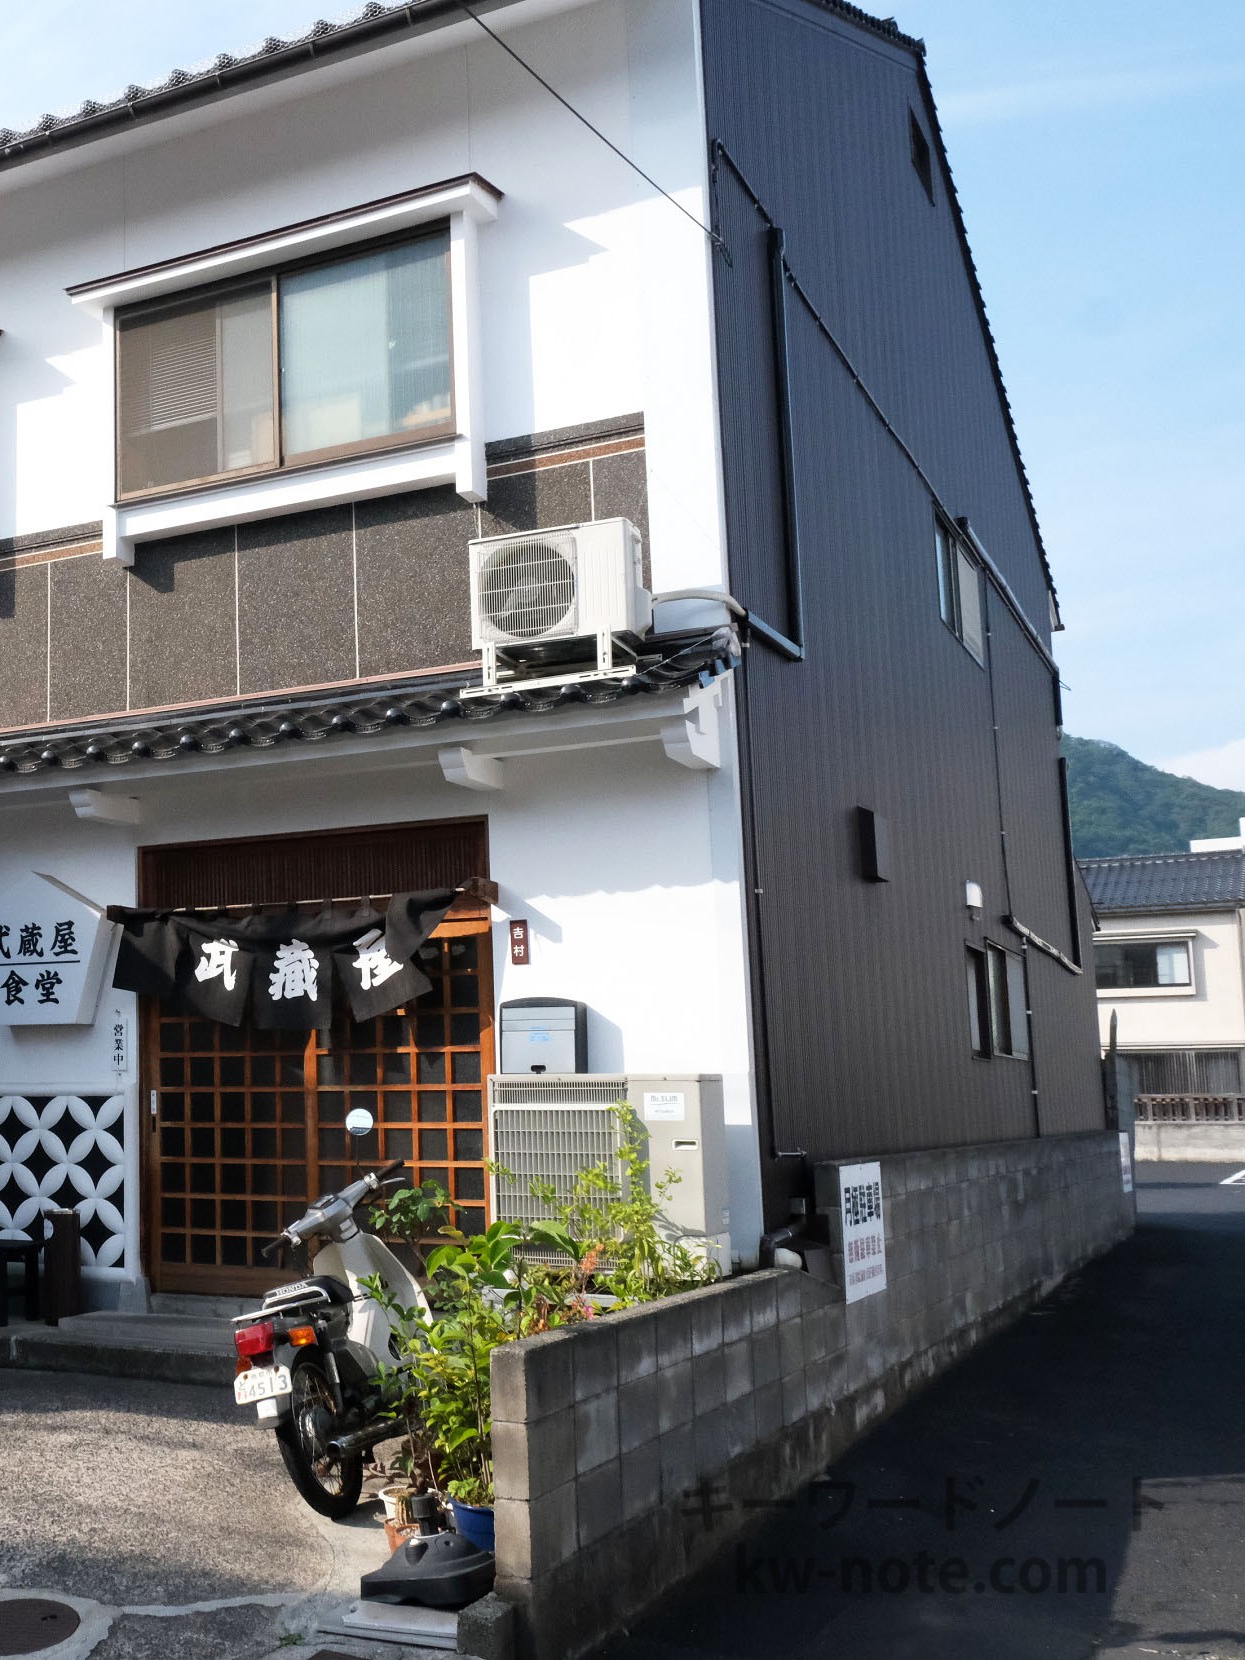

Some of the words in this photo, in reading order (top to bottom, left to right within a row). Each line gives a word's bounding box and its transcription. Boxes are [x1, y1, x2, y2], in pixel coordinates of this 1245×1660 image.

[512, 926, 525, 957] 吉村
[0, 969, 63, 1007] 食堂
[113, 1024, 124, 1066] 営業中
[275, 1282, 309, 1296] HONDA
